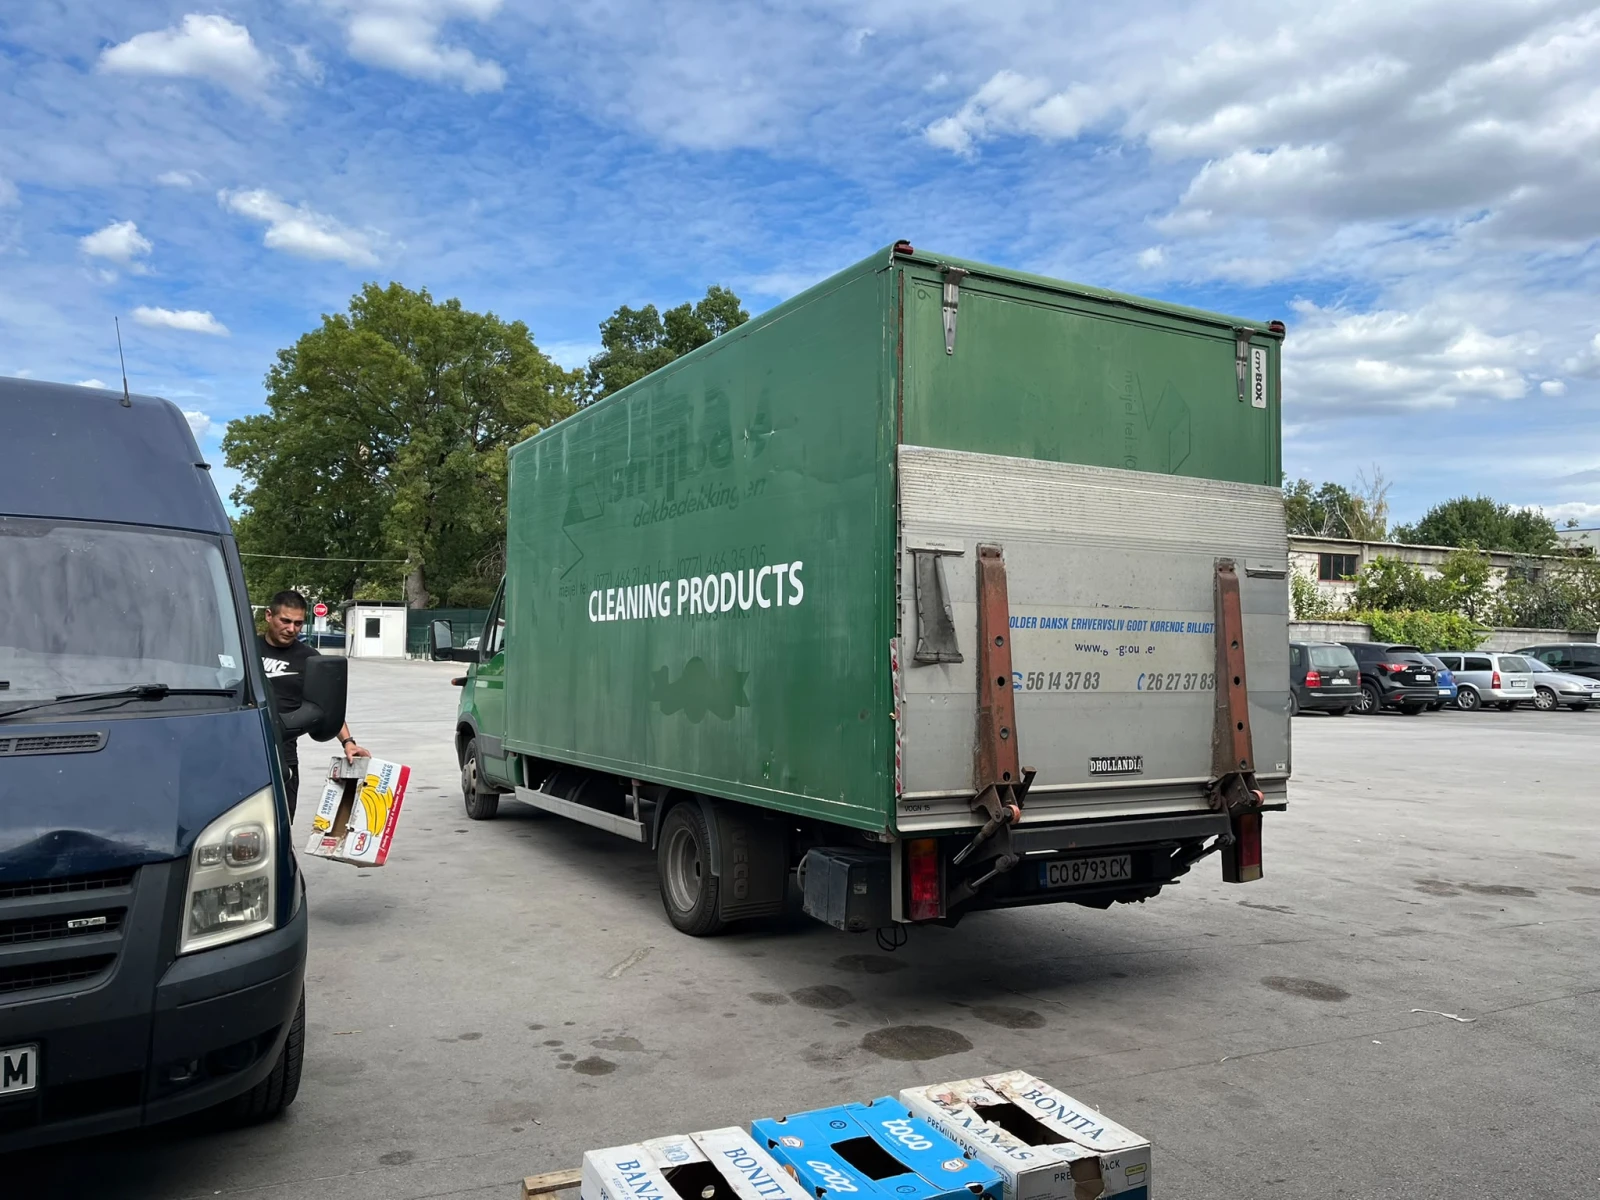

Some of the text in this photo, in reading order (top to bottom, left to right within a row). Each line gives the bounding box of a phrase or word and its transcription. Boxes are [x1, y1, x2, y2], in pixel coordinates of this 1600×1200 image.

[588, 580, 671, 622] CLEANING
[677, 561, 804, 616] PRODUCTS
[1008, 616, 1038, 628] OLDER
[1040, 617, 1070, 630] DANSK
[1072, 618, 1125, 631] ERHVERVSLIV
[1126, 620, 1148, 632] GODT
[1150, 620, 1184, 633] KØRENDE
[1026, 672, 1100, 690] 56 14 37 83
[1146, 673, 1216, 690] 26 27 37 83
[1090, 758, 1142, 772] DHOLLANDIA
[1022, 1089, 1106, 1142] BONITA
[882, 1118, 933, 1150] toco
[723, 1147, 792, 1200] BONIT
[806, 1160, 858, 1193] toco
